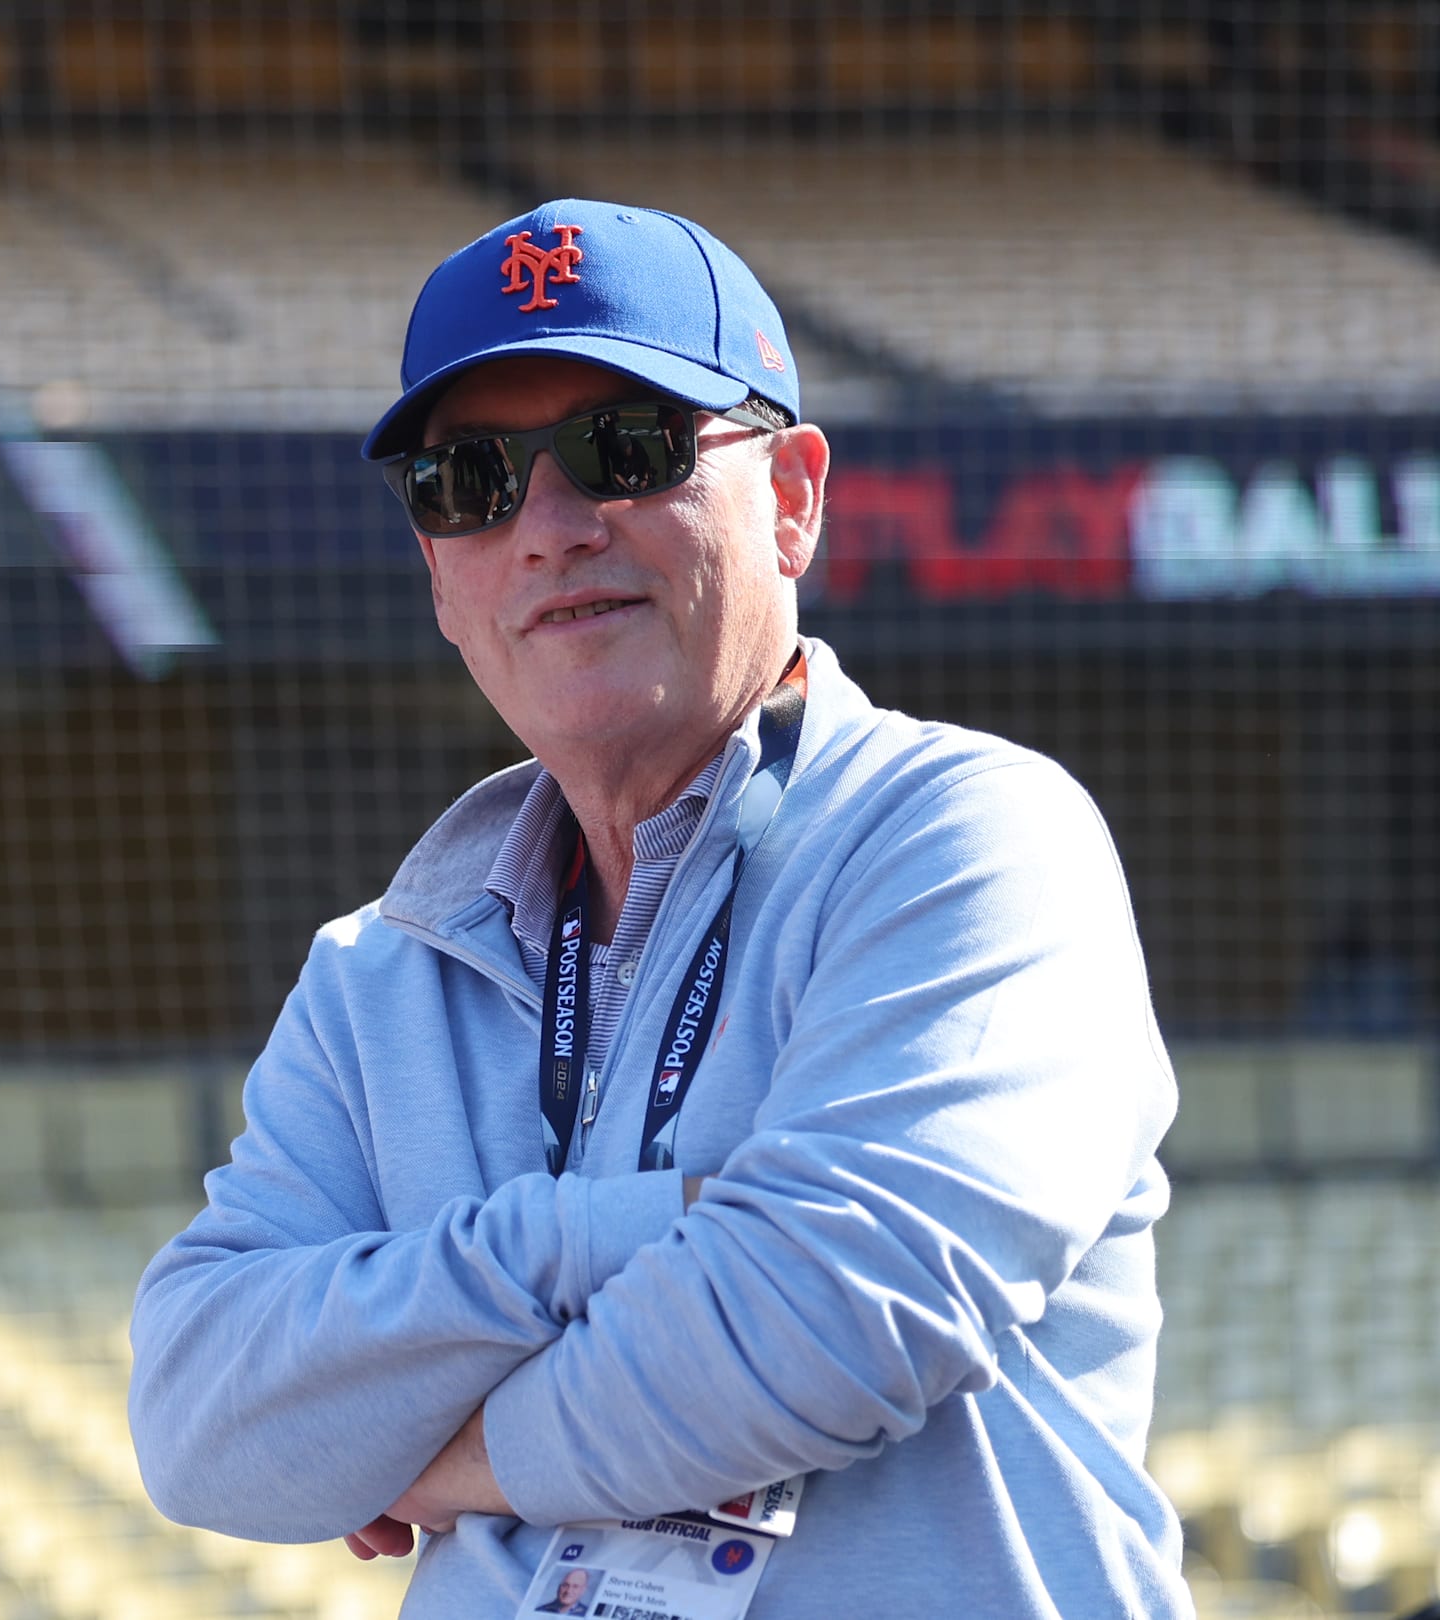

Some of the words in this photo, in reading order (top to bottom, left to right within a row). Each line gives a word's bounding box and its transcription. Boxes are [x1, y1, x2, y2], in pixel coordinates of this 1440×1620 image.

[554, 937, 580, 1057] POSTSEASON
[664, 937, 723, 1068] POSTSEASON
[556, 1061, 568, 1100] 2024
[621, 1519, 656, 1531] CLUB
[655, 1519, 711, 1541] OFFICIAL
[602, 1589, 621, 1599] New
[623, 1592, 643, 1603] York
[608, 1576, 633, 1588] Steve
[634, 1580, 665, 1593] Cohen
